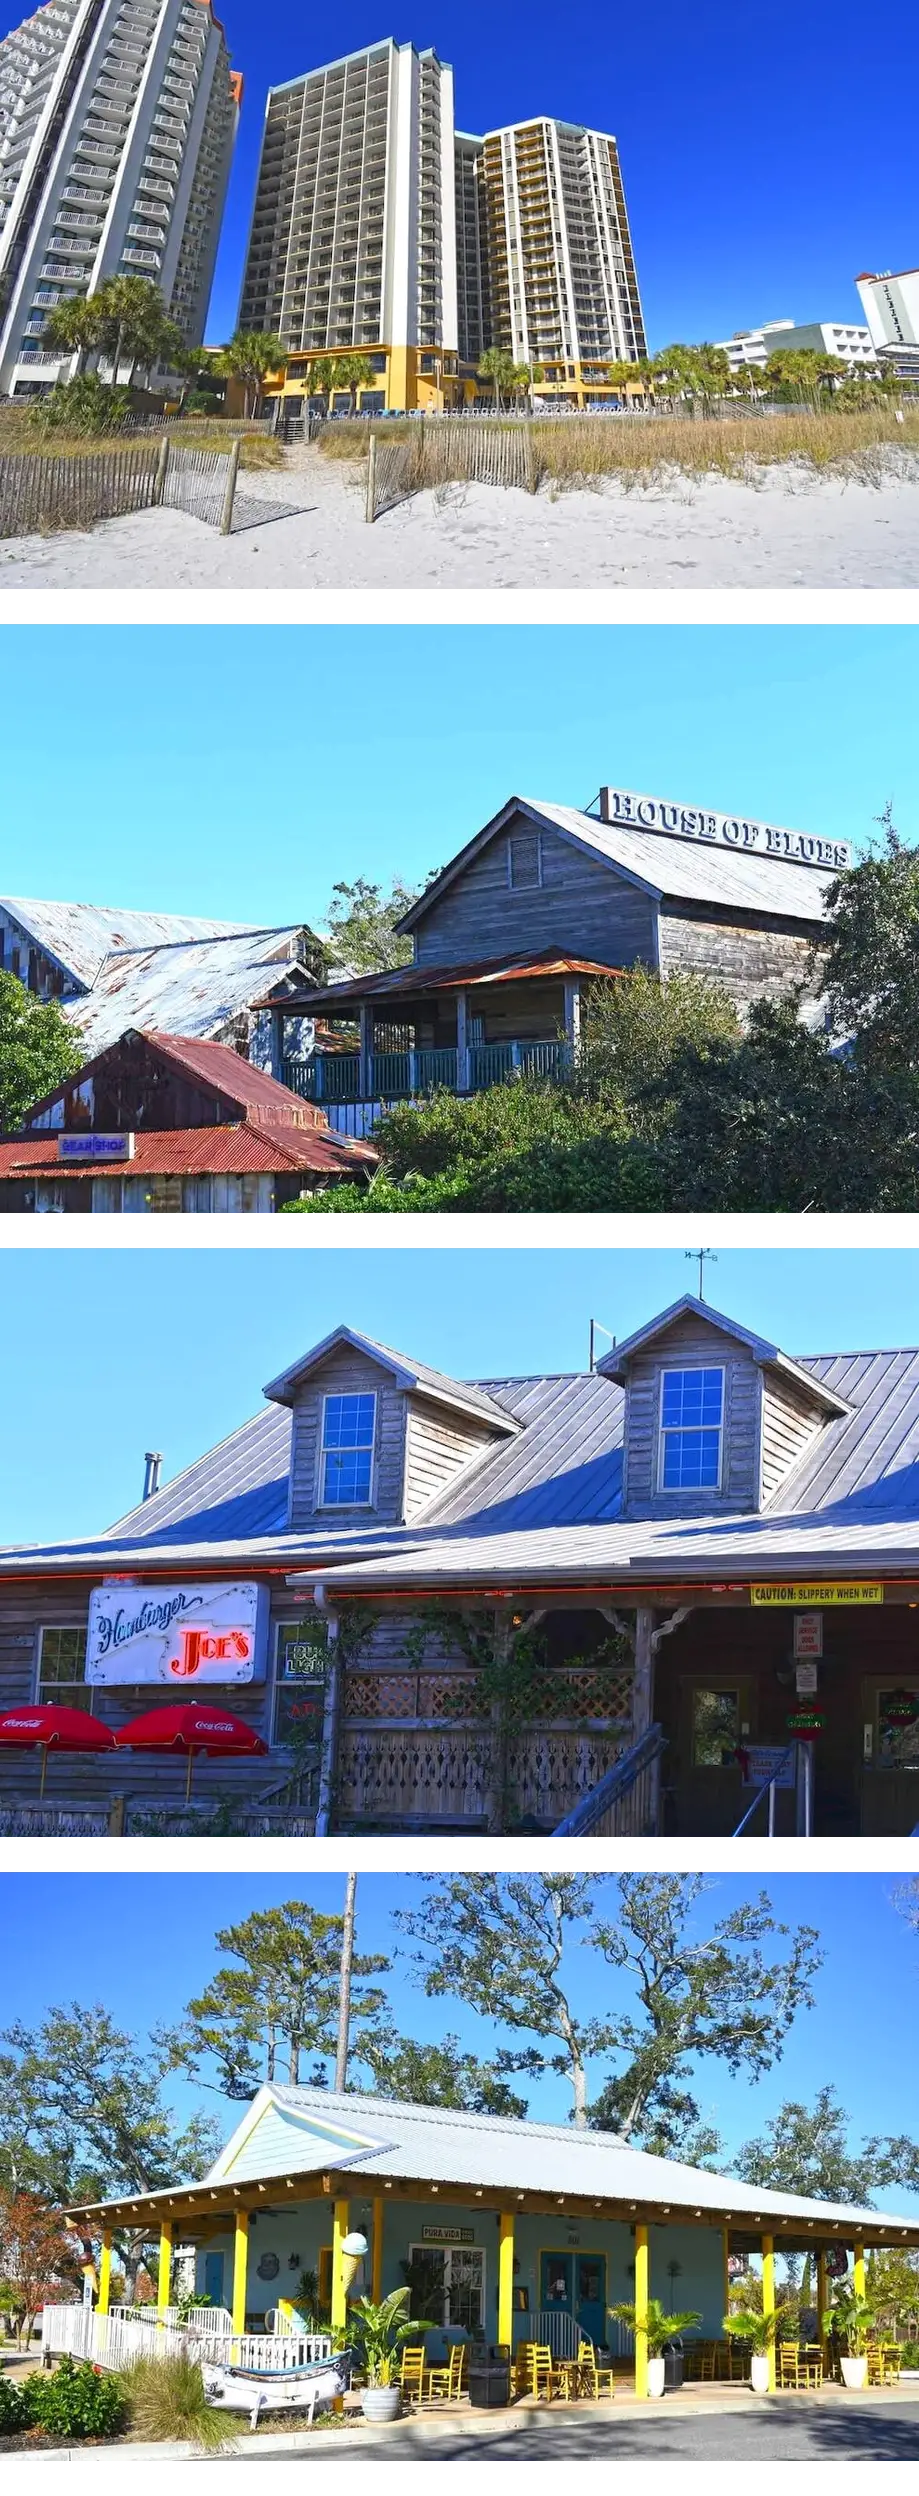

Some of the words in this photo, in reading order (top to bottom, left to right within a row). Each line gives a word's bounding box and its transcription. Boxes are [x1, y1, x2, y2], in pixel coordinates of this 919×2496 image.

[613, 792, 717, 839] HOUSE
[723, 818, 760, 847] OF
[765, 827, 849, 867] BLUES
[95, 1139, 126, 1151] SHOP
[754, 1587, 797, 1600] CAUTION:
[798, 1588, 834, 1600] SLIPPERY
[836, 1587, 860, 1599] WHEN
[862, 1587, 879, 1598] WET
[96, 1593, 203, 1653] Hamburger
[195, 1720, 234, 1731] Coca-Cola
